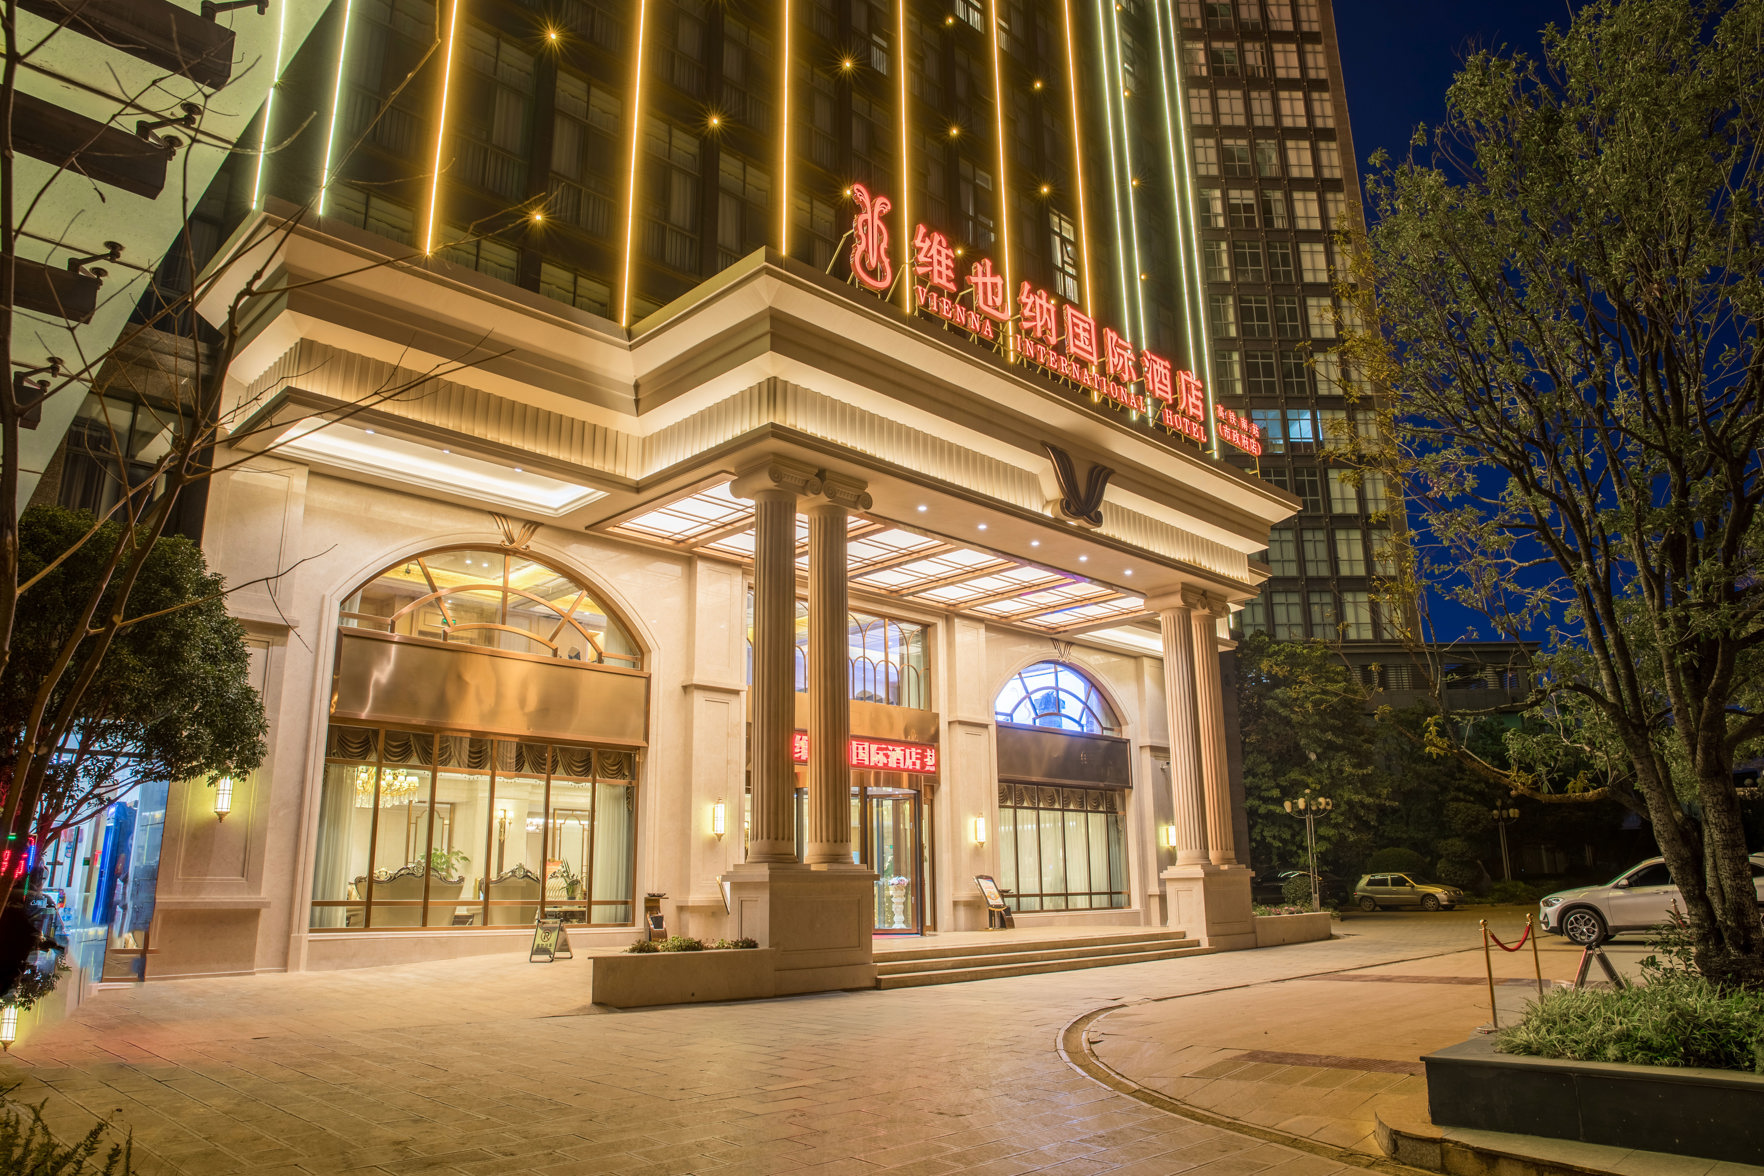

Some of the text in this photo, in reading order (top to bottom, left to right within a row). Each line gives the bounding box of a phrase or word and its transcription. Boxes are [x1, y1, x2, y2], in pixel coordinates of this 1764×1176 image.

[913, 223, 1204, 422] 维也纳国际酒店
[914, 284, 1207, 443] VIENNA INTERNATIONAL HOTEL
[1215, 404, 1260, 438] 高铁南站
